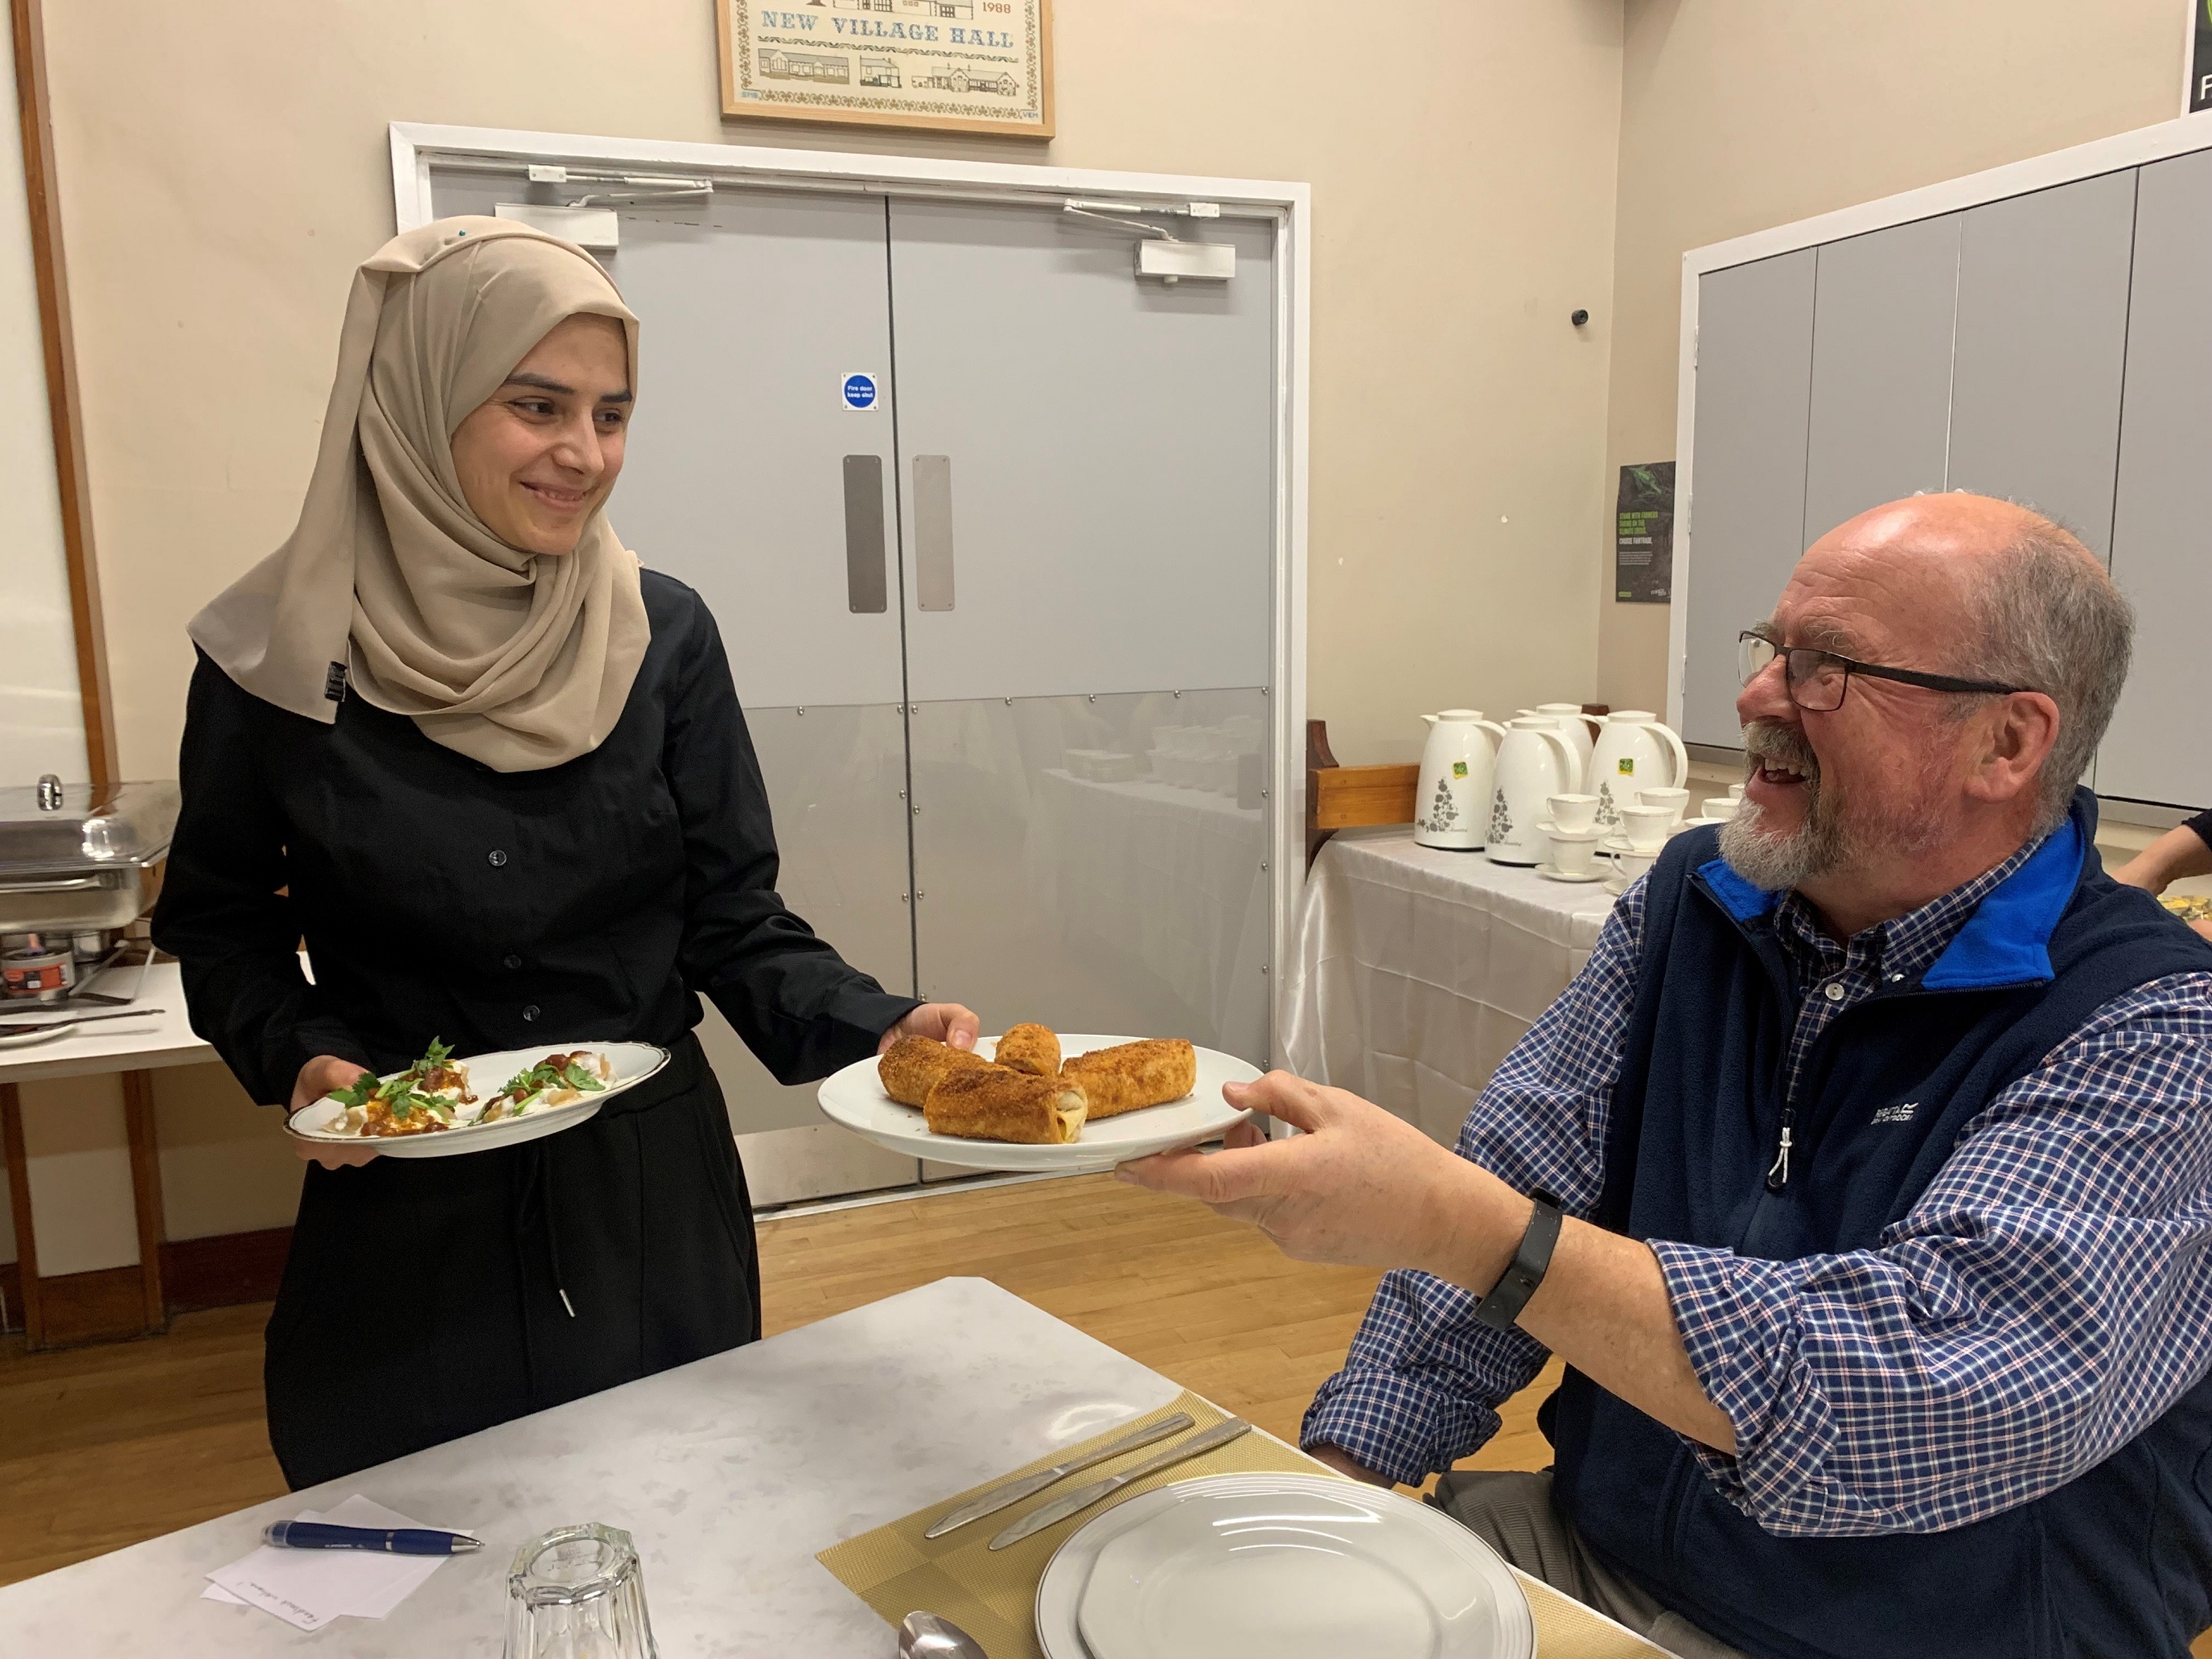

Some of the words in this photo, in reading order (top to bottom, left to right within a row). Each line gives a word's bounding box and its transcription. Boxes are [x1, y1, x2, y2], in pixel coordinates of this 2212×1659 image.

[982, 2, 1011, 14] 1988
[761, 10, 819, 31] NEW
[831, 17, 939, 41] VILLAGE
[949, 27, 1014, 48] HALL
